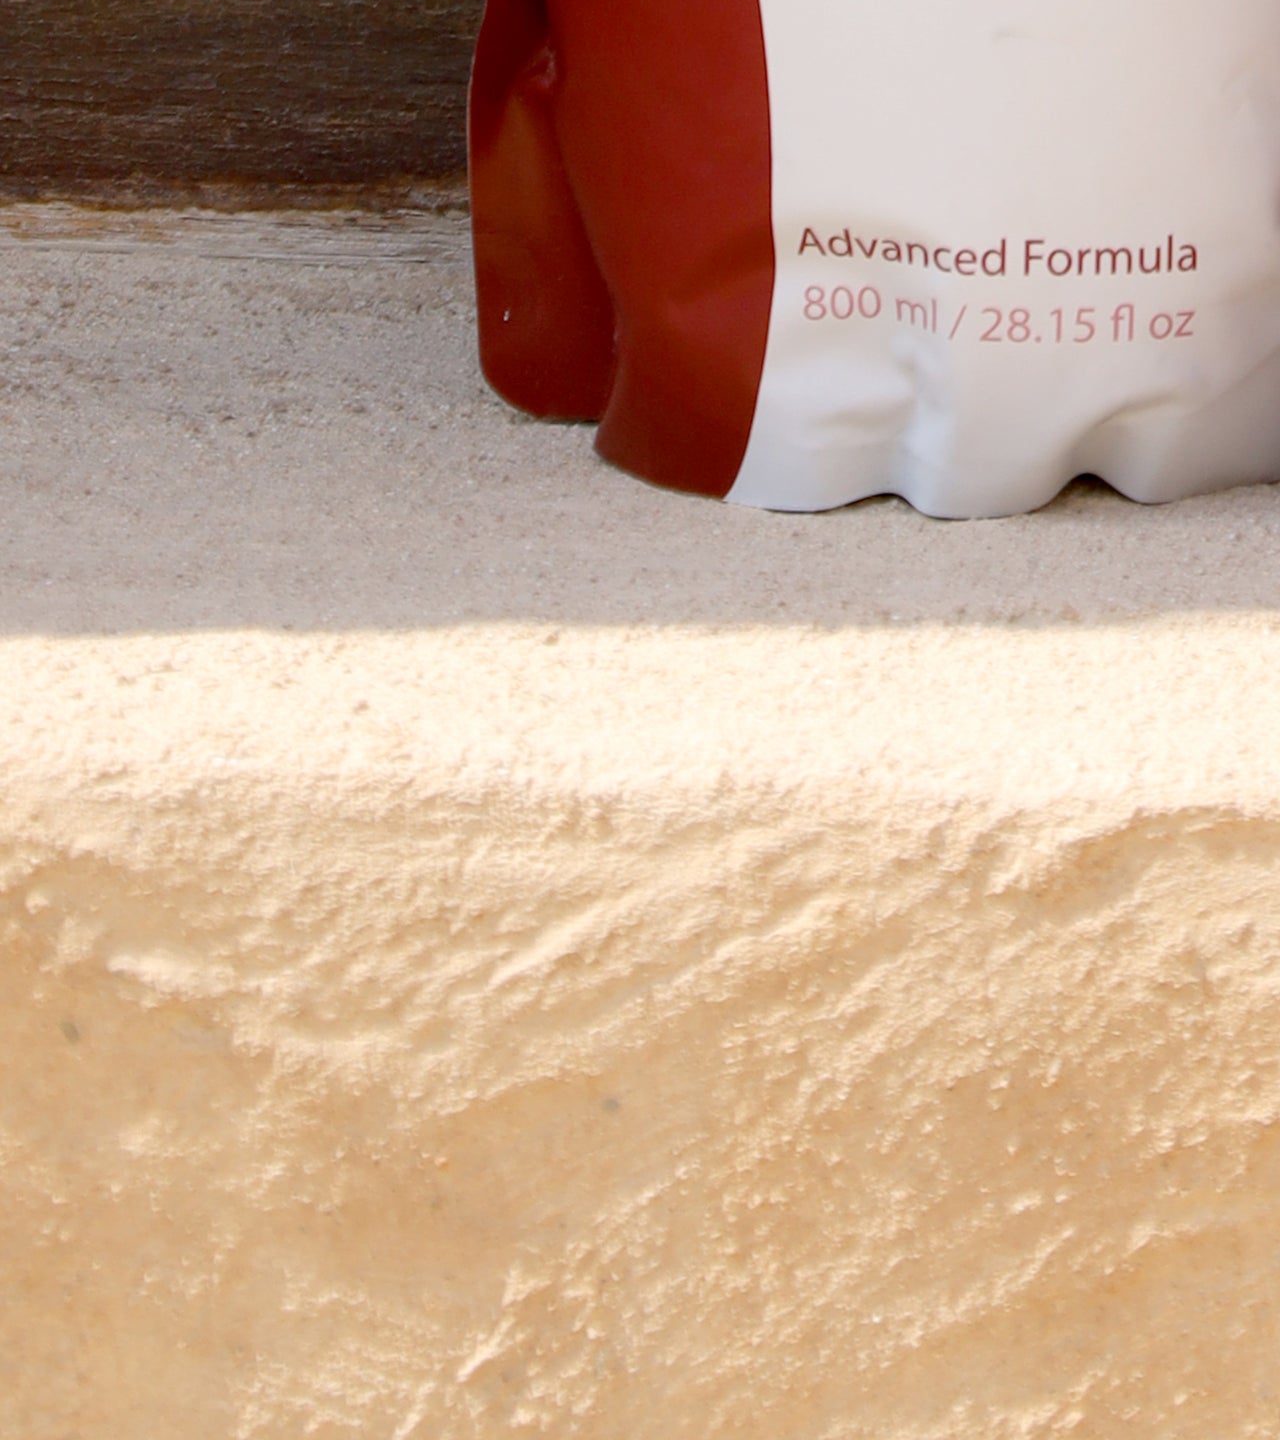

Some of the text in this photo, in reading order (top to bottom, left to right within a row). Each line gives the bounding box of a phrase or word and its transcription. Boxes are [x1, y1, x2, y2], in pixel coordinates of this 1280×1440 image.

[798, 227, 1198, 276] Advanced Formula
[802, 286, 882, 321] 800
[895, 295, 938, 335] ml
[979, 306, 1096, 345] 28.15
[1110, 304, 1135, 342] fl
[1148, 309, 1195, 341] oz
